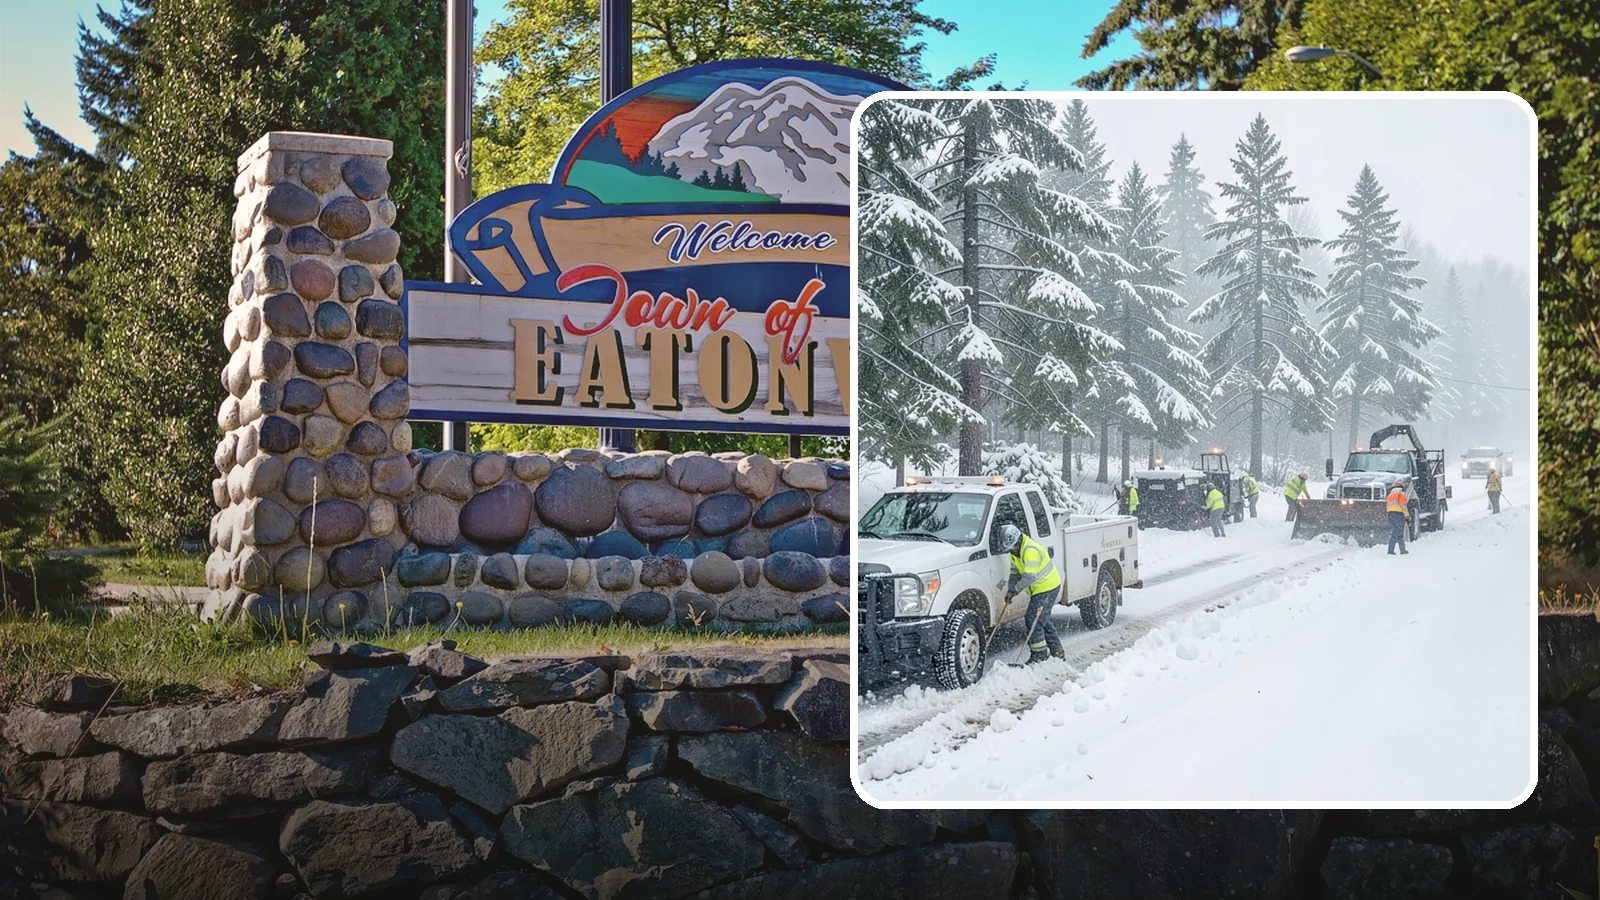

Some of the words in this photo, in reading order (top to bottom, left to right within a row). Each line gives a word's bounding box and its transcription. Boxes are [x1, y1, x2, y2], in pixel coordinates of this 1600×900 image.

[653, 221, 837, 263] Welcome
[556, 264, 735, 336] Town
[765, 278, 827, 366] of
